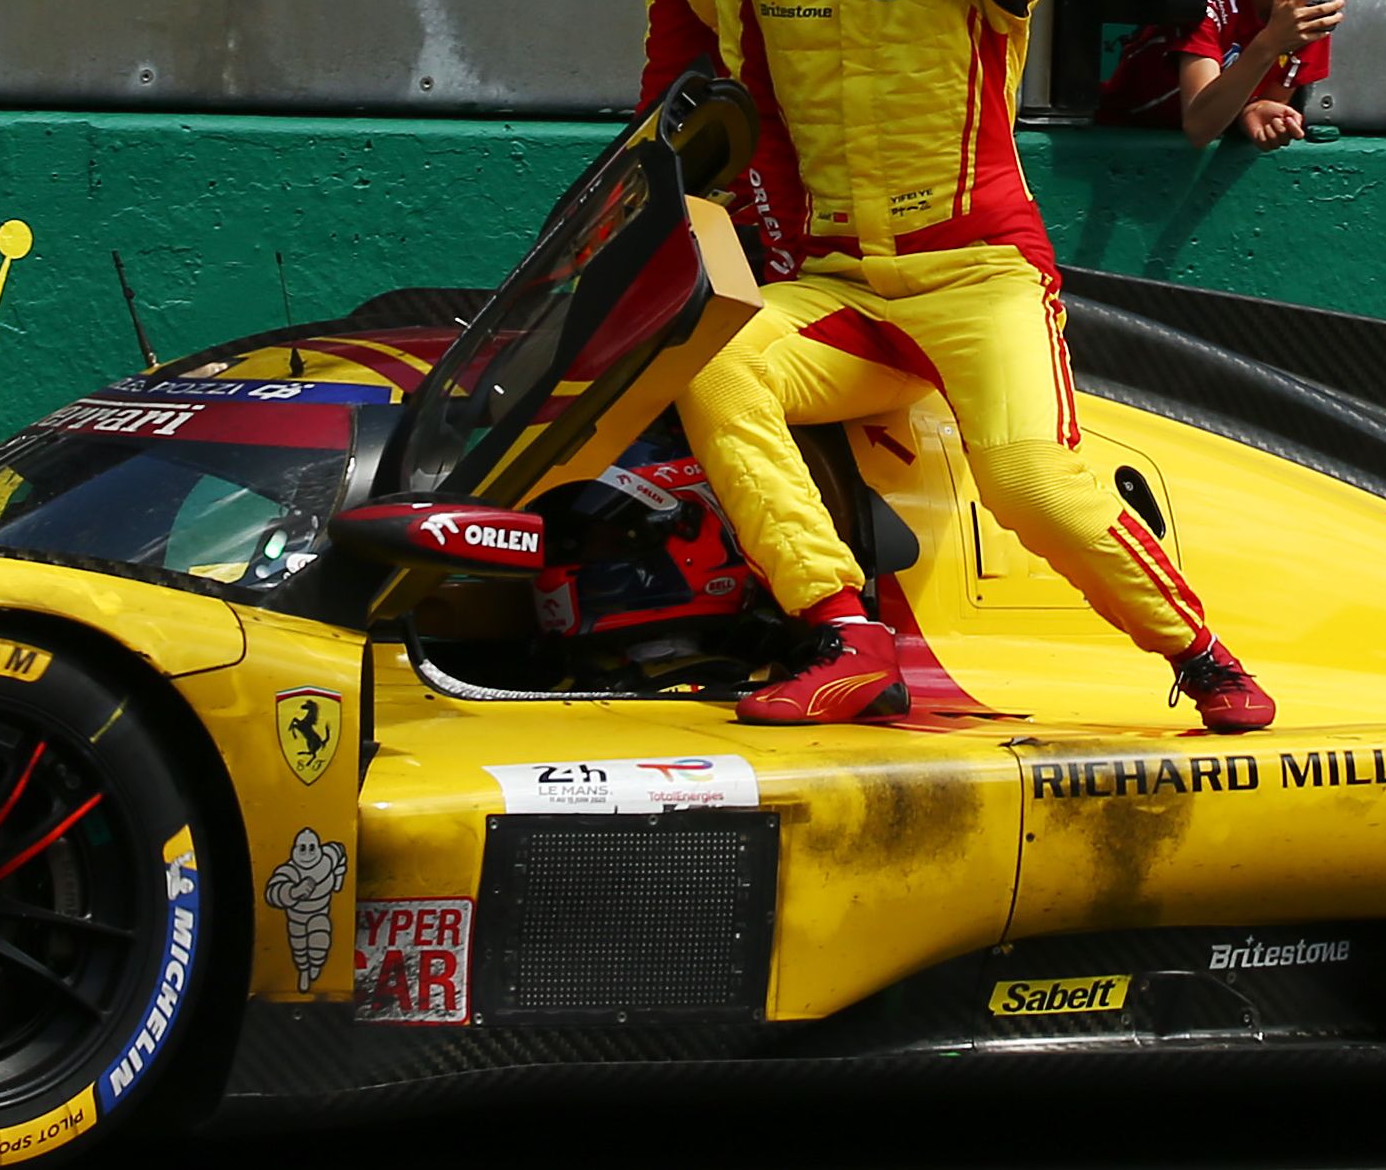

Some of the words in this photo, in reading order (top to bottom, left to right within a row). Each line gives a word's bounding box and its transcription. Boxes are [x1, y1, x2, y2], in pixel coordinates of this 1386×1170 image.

[760, 2, 833, 18] Britestone
[890, 191, 917, 204] YIFEI
[917, 188, 933, 198] YE
[148, 380, 245, 396] POZZI
[464, 524, 539, 553] ORLEN
[706, 578, 734, 593] BELL
[4, 645, 38, 675] M
[538, 785, 557, 796] LE
[561, 785, 610, 796] MANS
[1031, 754, 1261, 800] RICHARD
[647, 790, 725, 805] TotalEnergies
[1209, 935, 1350, 970] Britestone
[355, 949, 458, 1012] AR
[108, 906, 194, 1098] MICHELIN
[1002, 980, 1116, 1012] Sabelt
[36, 1108, 85, 1145] PILOT
